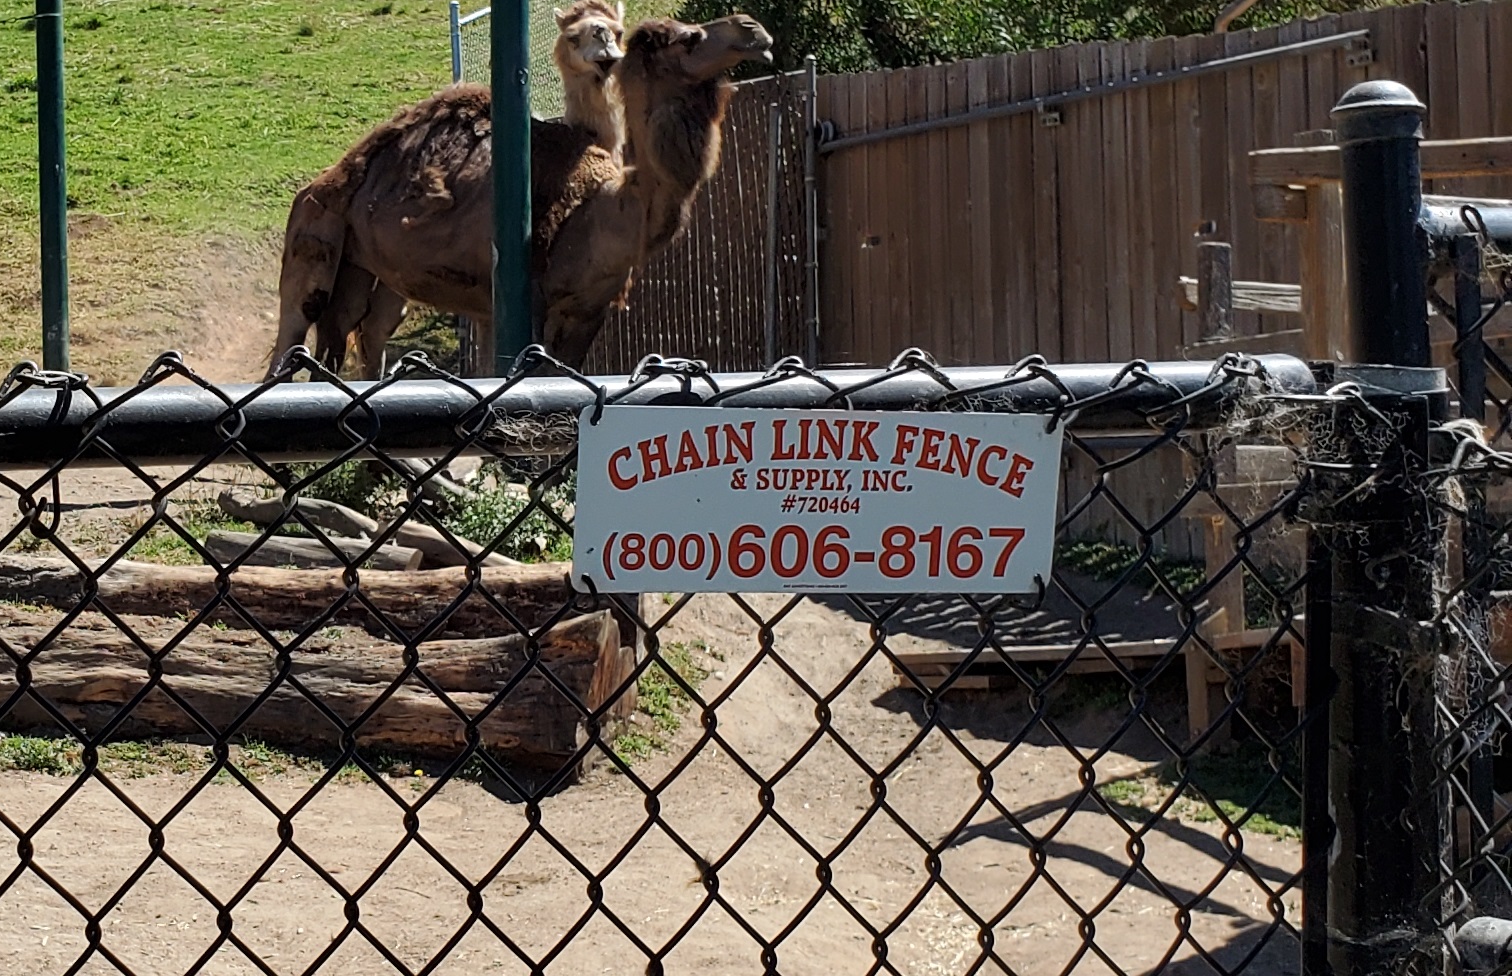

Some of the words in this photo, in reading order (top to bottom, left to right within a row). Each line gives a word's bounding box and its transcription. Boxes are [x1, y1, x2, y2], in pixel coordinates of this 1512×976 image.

[607, 420, 756, 491] CHAIN
[770, 418, 880, 463] LINK
[890, 424, 1035, 499] FENCE
[730, 468, 748, 490] &
[755, 468, 852, 494] SUPPLY,
[860, 469, 913, 492] INC.
[780, 495, 861, 515] #720464
